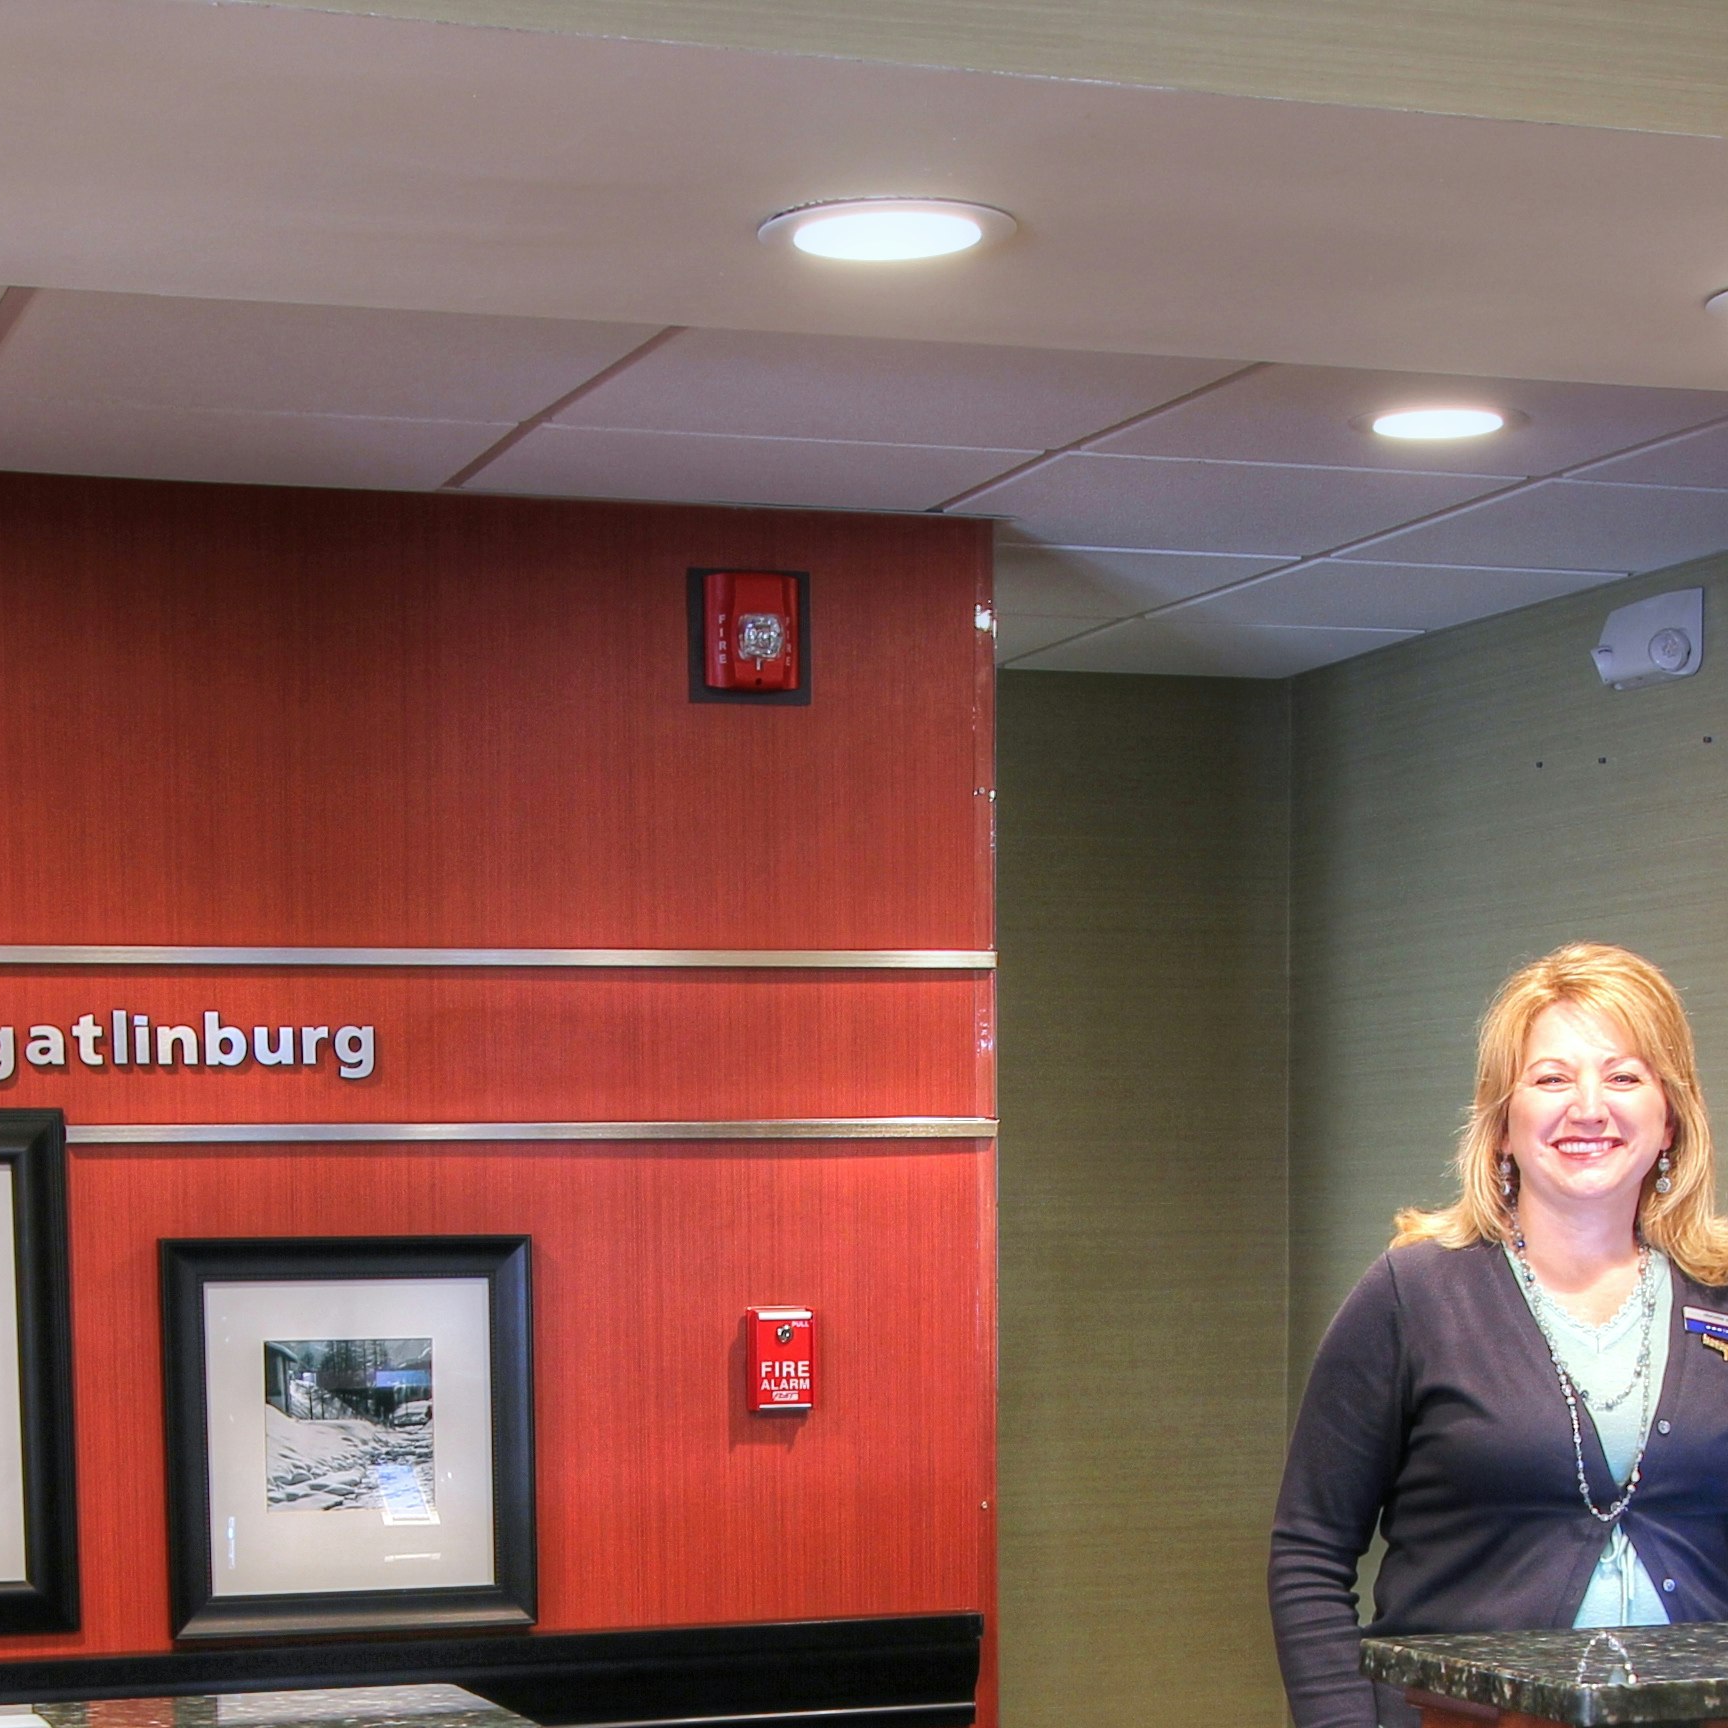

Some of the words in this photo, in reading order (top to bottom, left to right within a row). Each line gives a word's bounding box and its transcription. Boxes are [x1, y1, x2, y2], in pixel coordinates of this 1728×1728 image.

[718, 614, 728, 664] FIRE
[791, 1320, 809, 1328] PULL
[761, 1361, 810, 1378] FIRE
[761, 1378, 810, 1390] ALARM
